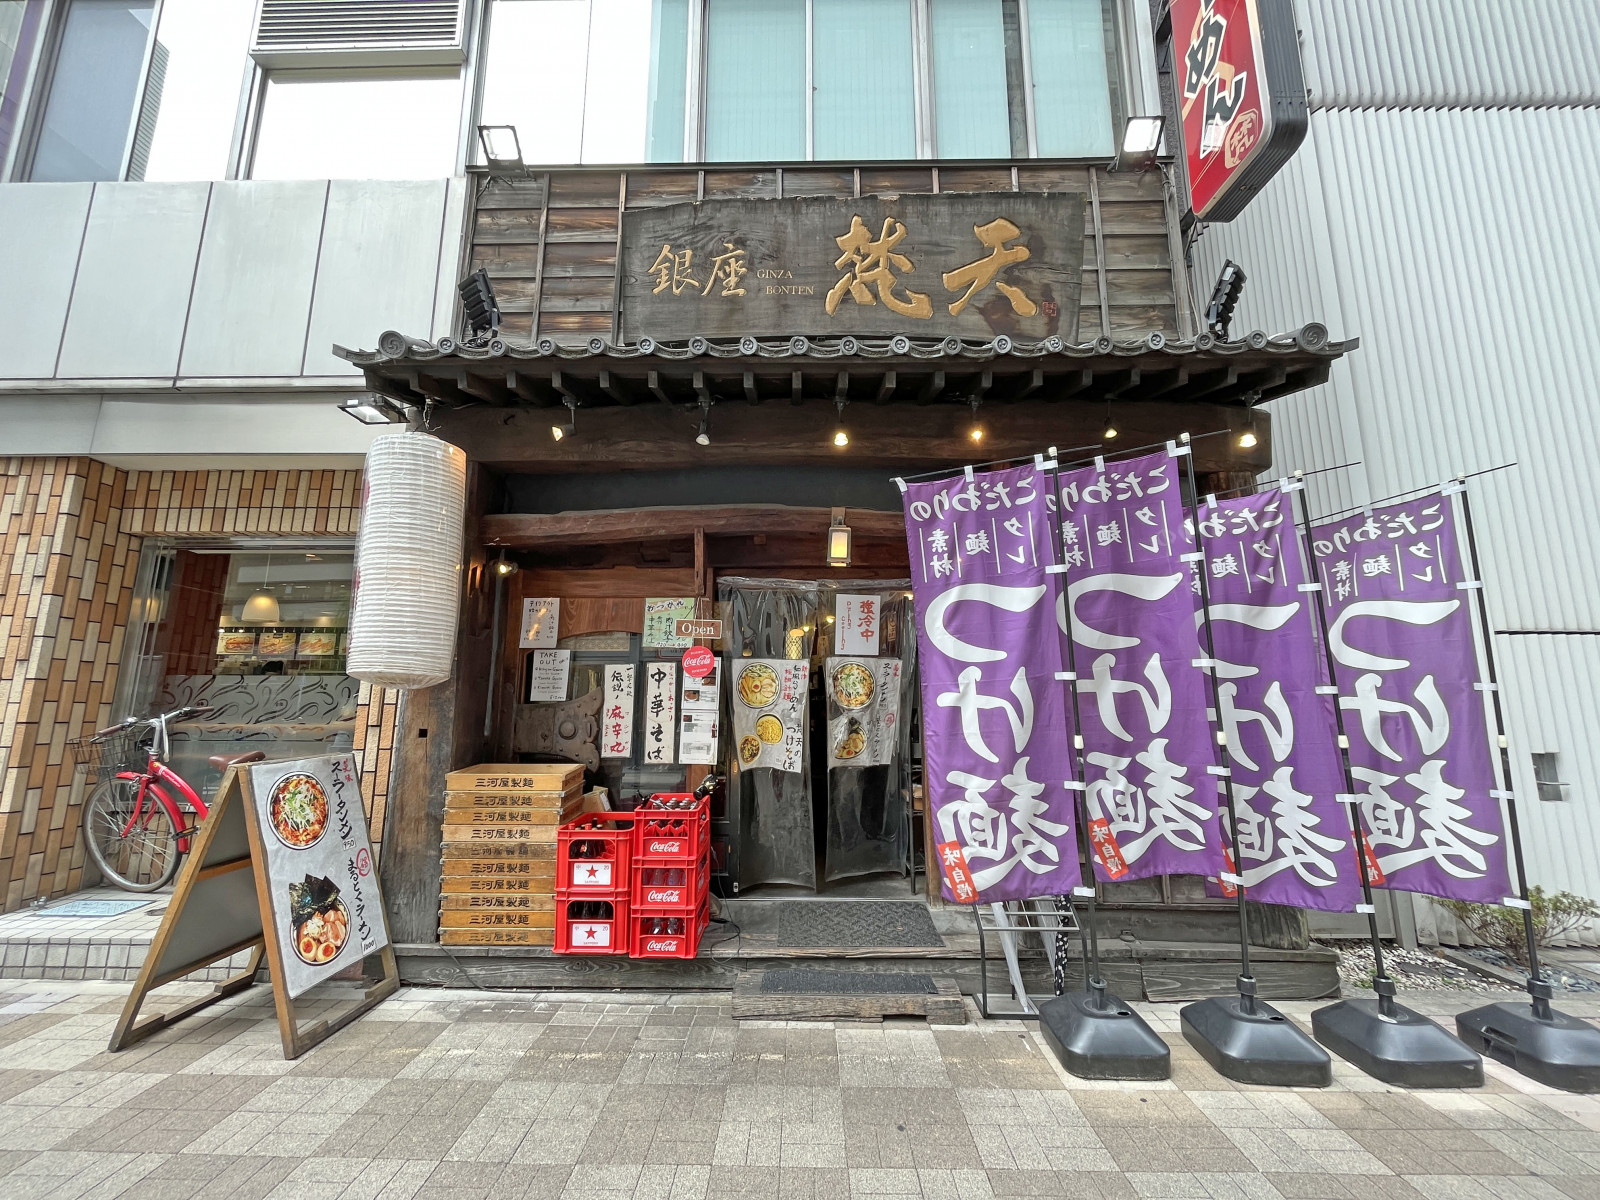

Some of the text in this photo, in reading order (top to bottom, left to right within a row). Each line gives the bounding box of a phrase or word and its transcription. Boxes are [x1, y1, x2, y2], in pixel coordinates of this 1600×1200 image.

[648, 243, 748, 297] 銀座
[756, 269, 793, 279] GINZA
[825, 213, 1037, 320] 梵天
[766, 285, 814, 295] BONTEN
[682, 622, 715, 637] Open
[857, 600, 875, 643] 強冷中
[540, 651, 558, 659] TAKE
[647, 667, 667, 761] 中華そば
[331, 760, 353, 840] スーラータンメン
[347, 857, 371, 941] まるとくラーメン
[363, 939, 375, 951] 1000
